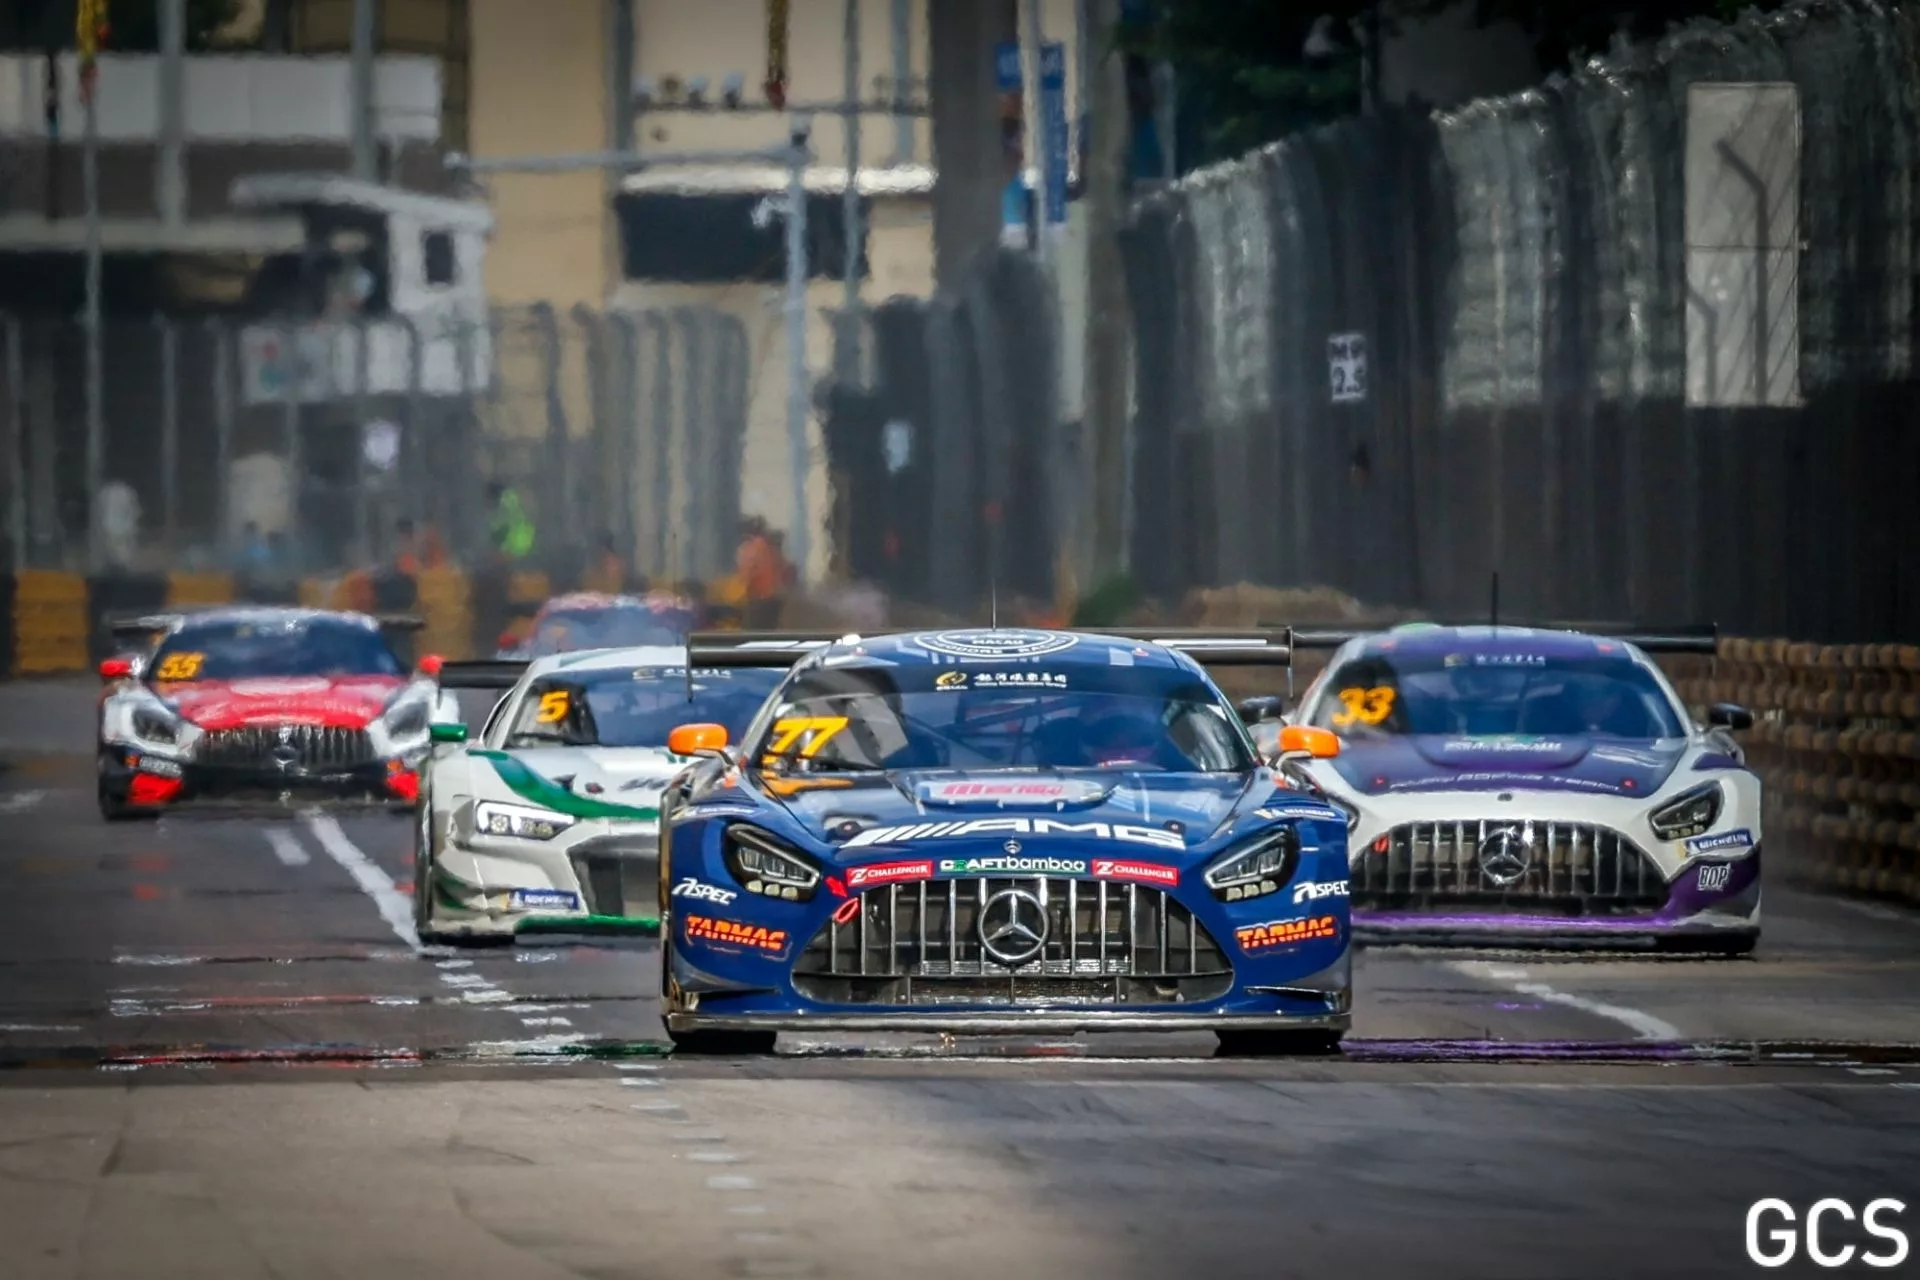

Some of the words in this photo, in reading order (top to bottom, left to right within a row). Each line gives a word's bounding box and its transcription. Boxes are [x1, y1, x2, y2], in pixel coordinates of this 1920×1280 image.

[157, 652, 204, 678] 55
[536, 690, 569, 722] 5
[1332, 686, 1394, 725] 33
[772, 716, 849, 756] 77
[950, 818, 1186, 850] AMG
[868, 865, 928, 877] CHALLENGER
[1114, 865, 1175, 879] CHALLENGER
[687, 915, 786, 951] TARMAC
[1236, 915, 1335, 949] TARMAC
